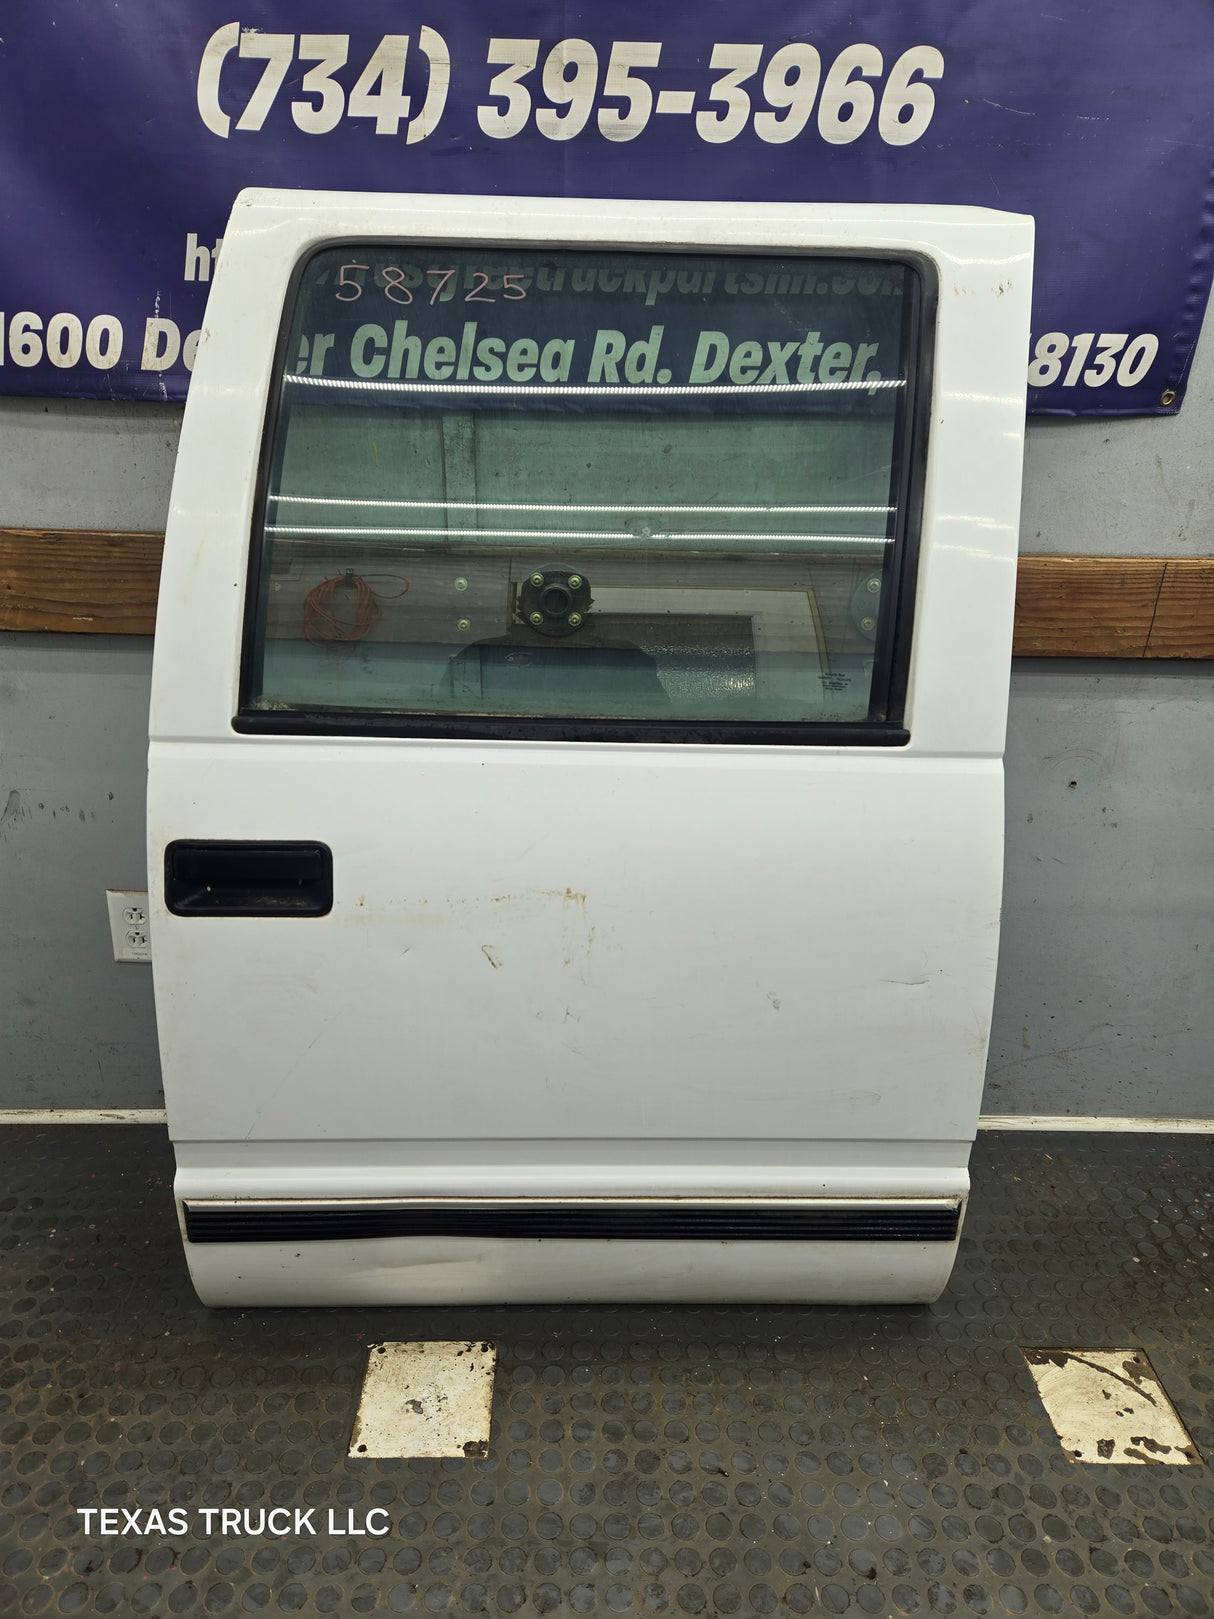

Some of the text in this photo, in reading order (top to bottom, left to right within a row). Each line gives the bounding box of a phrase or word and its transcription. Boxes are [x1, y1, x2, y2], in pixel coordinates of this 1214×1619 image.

[198, 22, 944, 146] (734) 395-3966
[336, 265, 527, 304] 58725
[350, 320, 575, 382] Chelsea
[587, 325, 672, 383] Rd.
[688, 331, 882, 395] Dexter,
[1028, 332, 1159, 388] 8130
